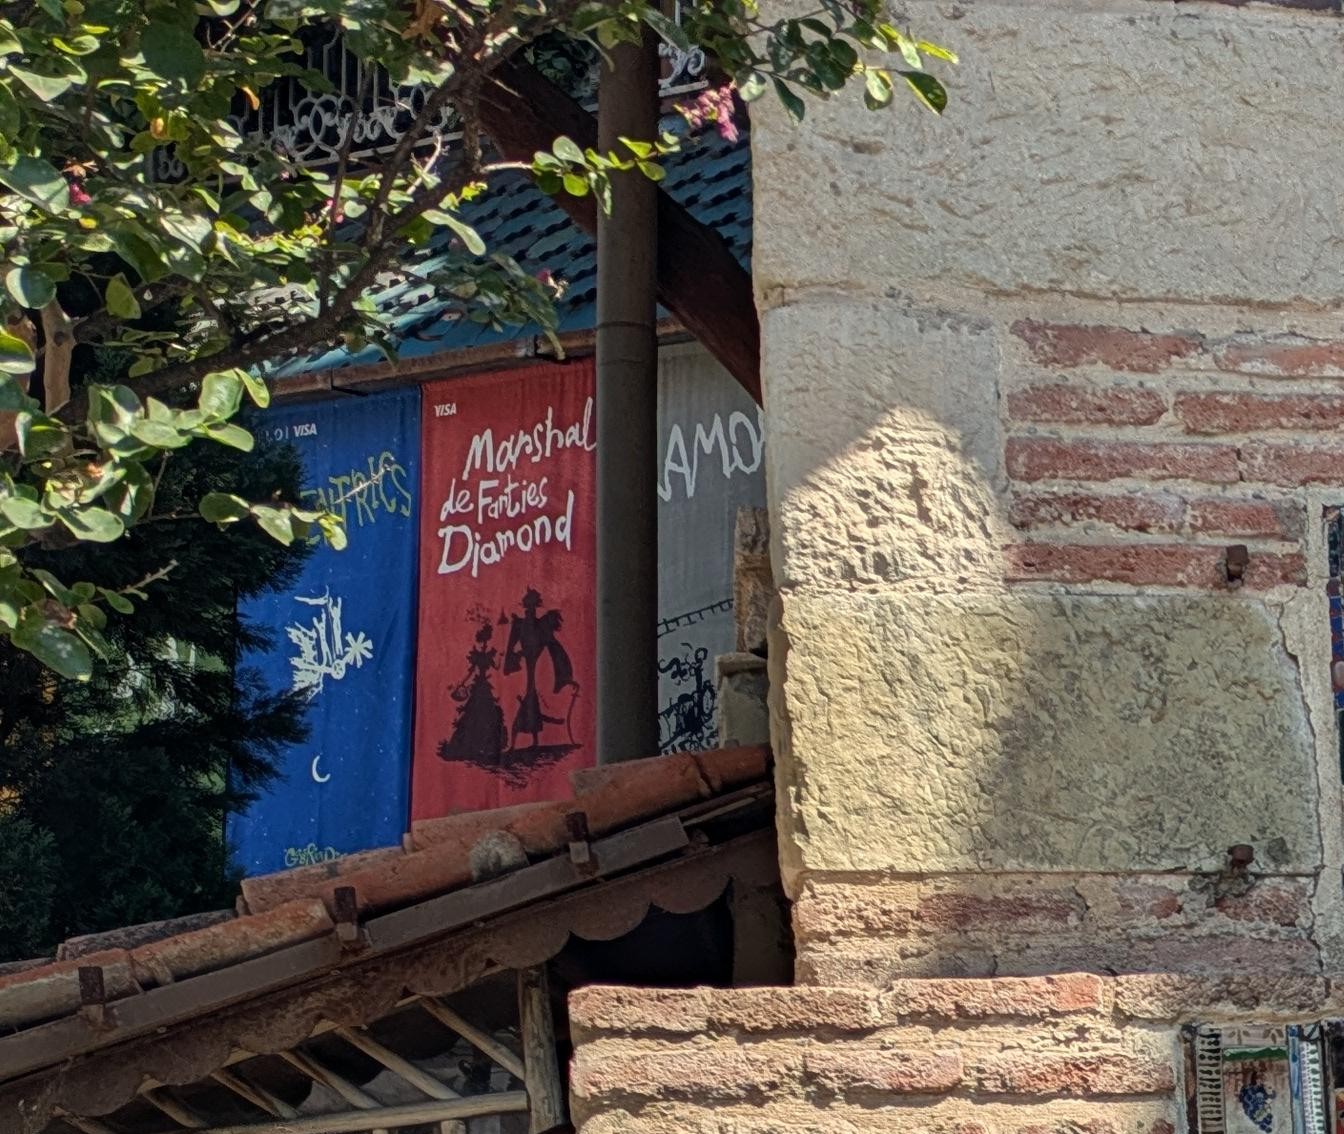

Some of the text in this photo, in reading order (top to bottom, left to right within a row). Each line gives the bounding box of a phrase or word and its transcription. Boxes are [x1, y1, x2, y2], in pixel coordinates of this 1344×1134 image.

[293, 423, 318, 437] VISA
[434, 403, 457, 417] VISA
[462, 396, 597, 480] Marshal
[657, 404, 765, 502] AMO
[440, 478, 474, 521] de
[437, 489, 574, 578] Diamond
